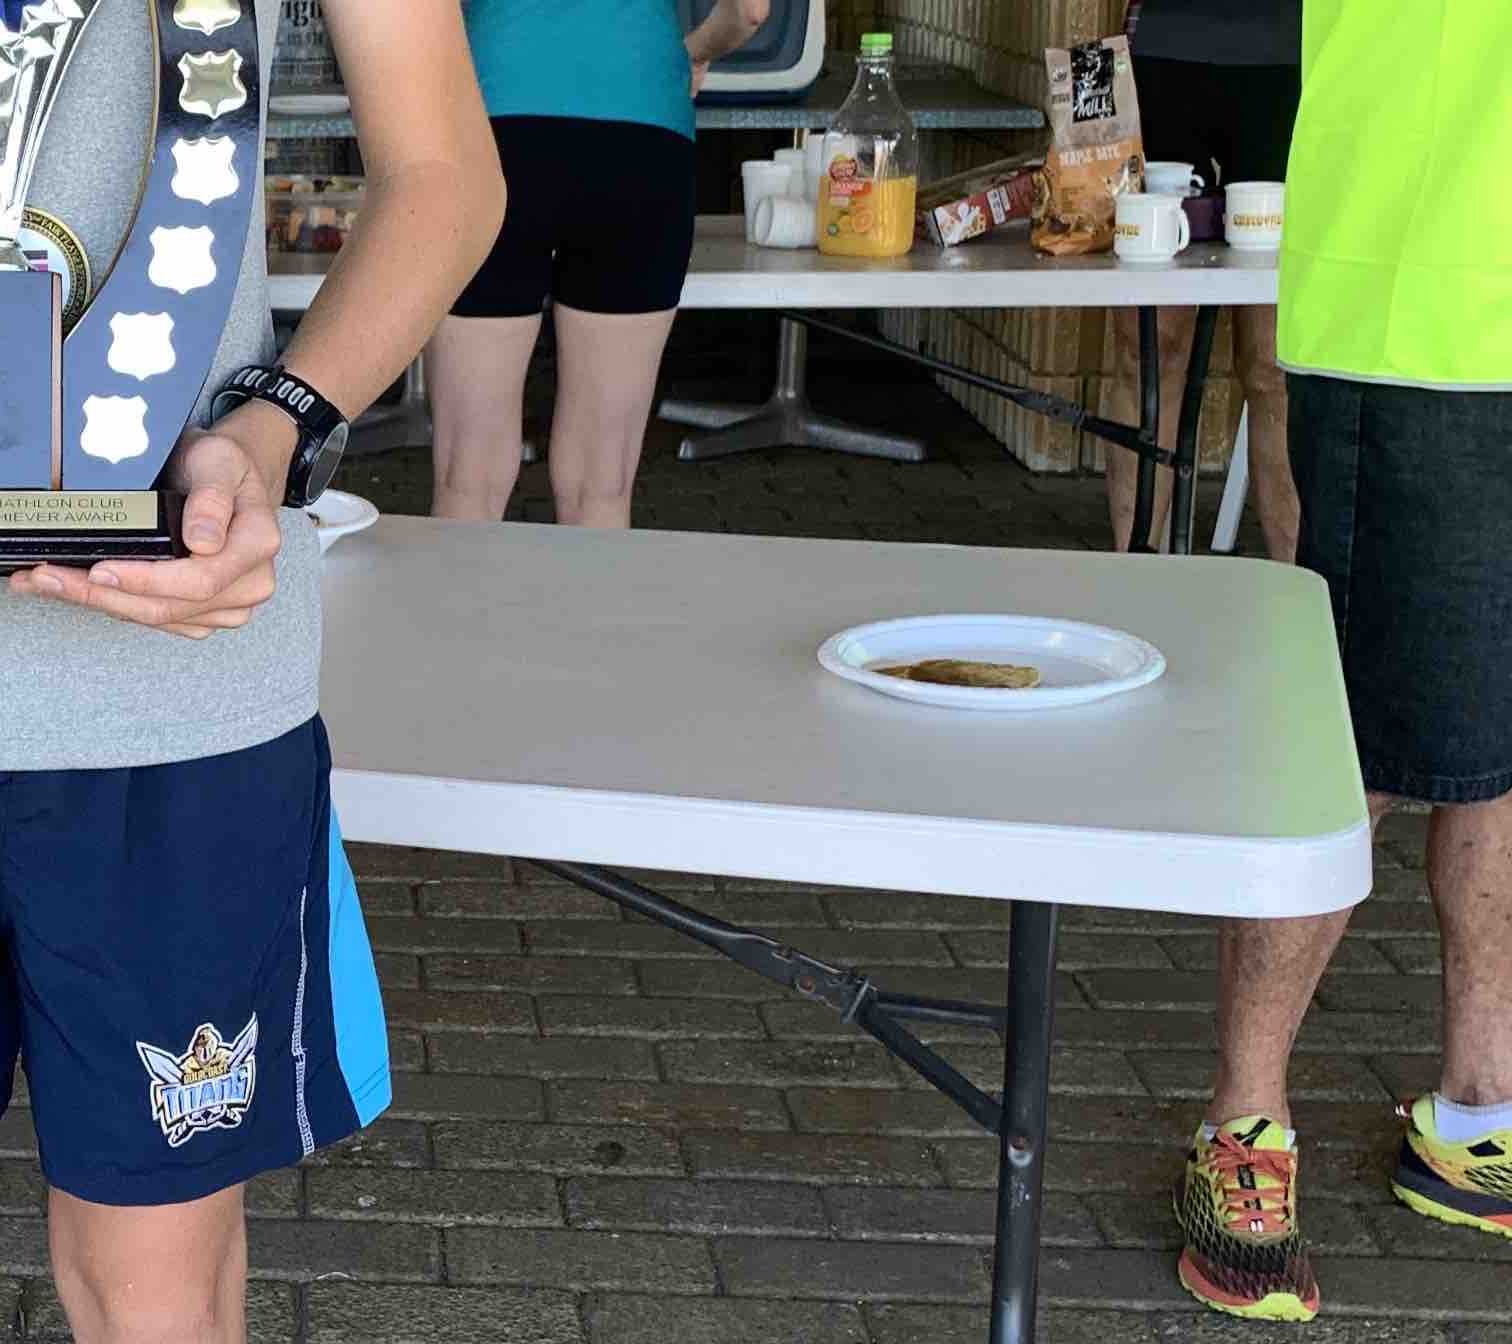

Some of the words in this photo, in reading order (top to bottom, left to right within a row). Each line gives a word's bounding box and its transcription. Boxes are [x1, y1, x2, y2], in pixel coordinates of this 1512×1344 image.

[77, 496, 124, 509] CLUB
[64, 511, 128, 523] AWARD
[161, 1064, 249, 1121] TITANS
